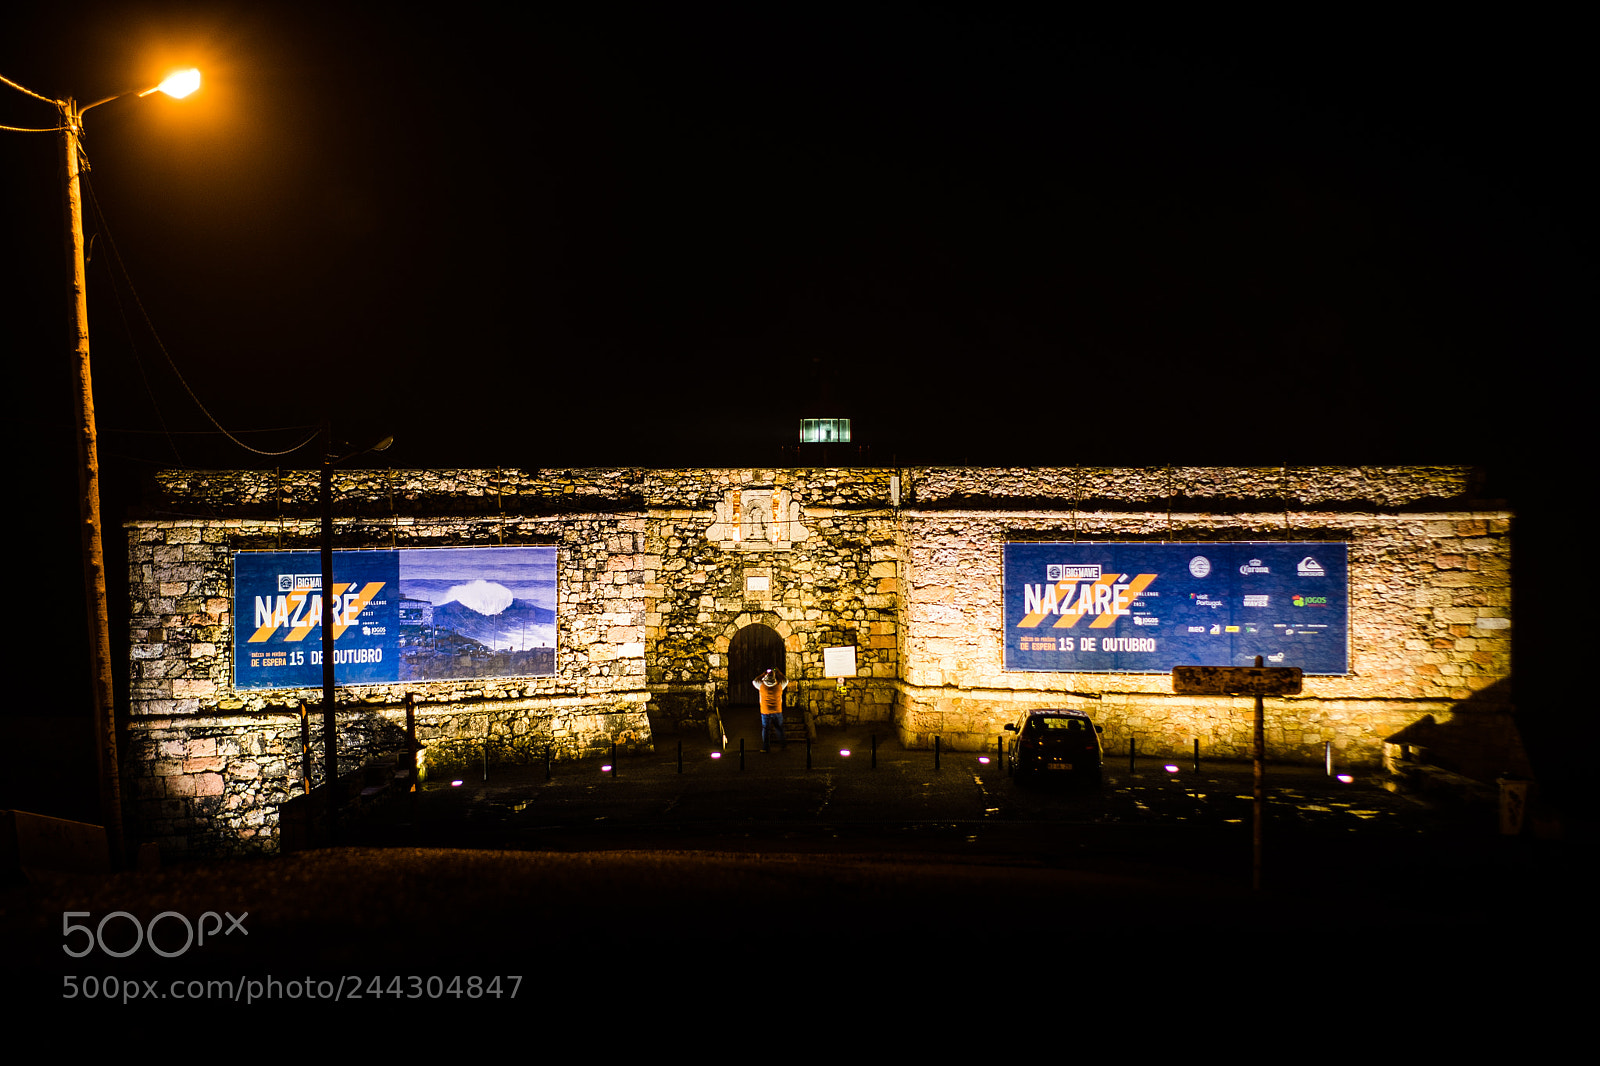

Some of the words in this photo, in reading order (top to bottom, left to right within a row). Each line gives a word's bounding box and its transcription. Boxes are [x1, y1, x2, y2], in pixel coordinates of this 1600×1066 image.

[1024, 573, 1130, 615] NAZARÉ
[1304, 596, 1327, 605] JOGOS
[1020, 642, 1029, 651] DE
[1031, 642, 1056, 651] ESPERA
[1059, 637, 1074, 651] 15
[1080, 637, 1097, 652] DE
[1102, 637, 1156, 652] OUTUBRO
[251, 659, 260, 667] DE
[263, 658, 287, 667] ESPERA
[289, 651, 304, 666] 15
[333, 648, 383, 664] OUTUBRO
